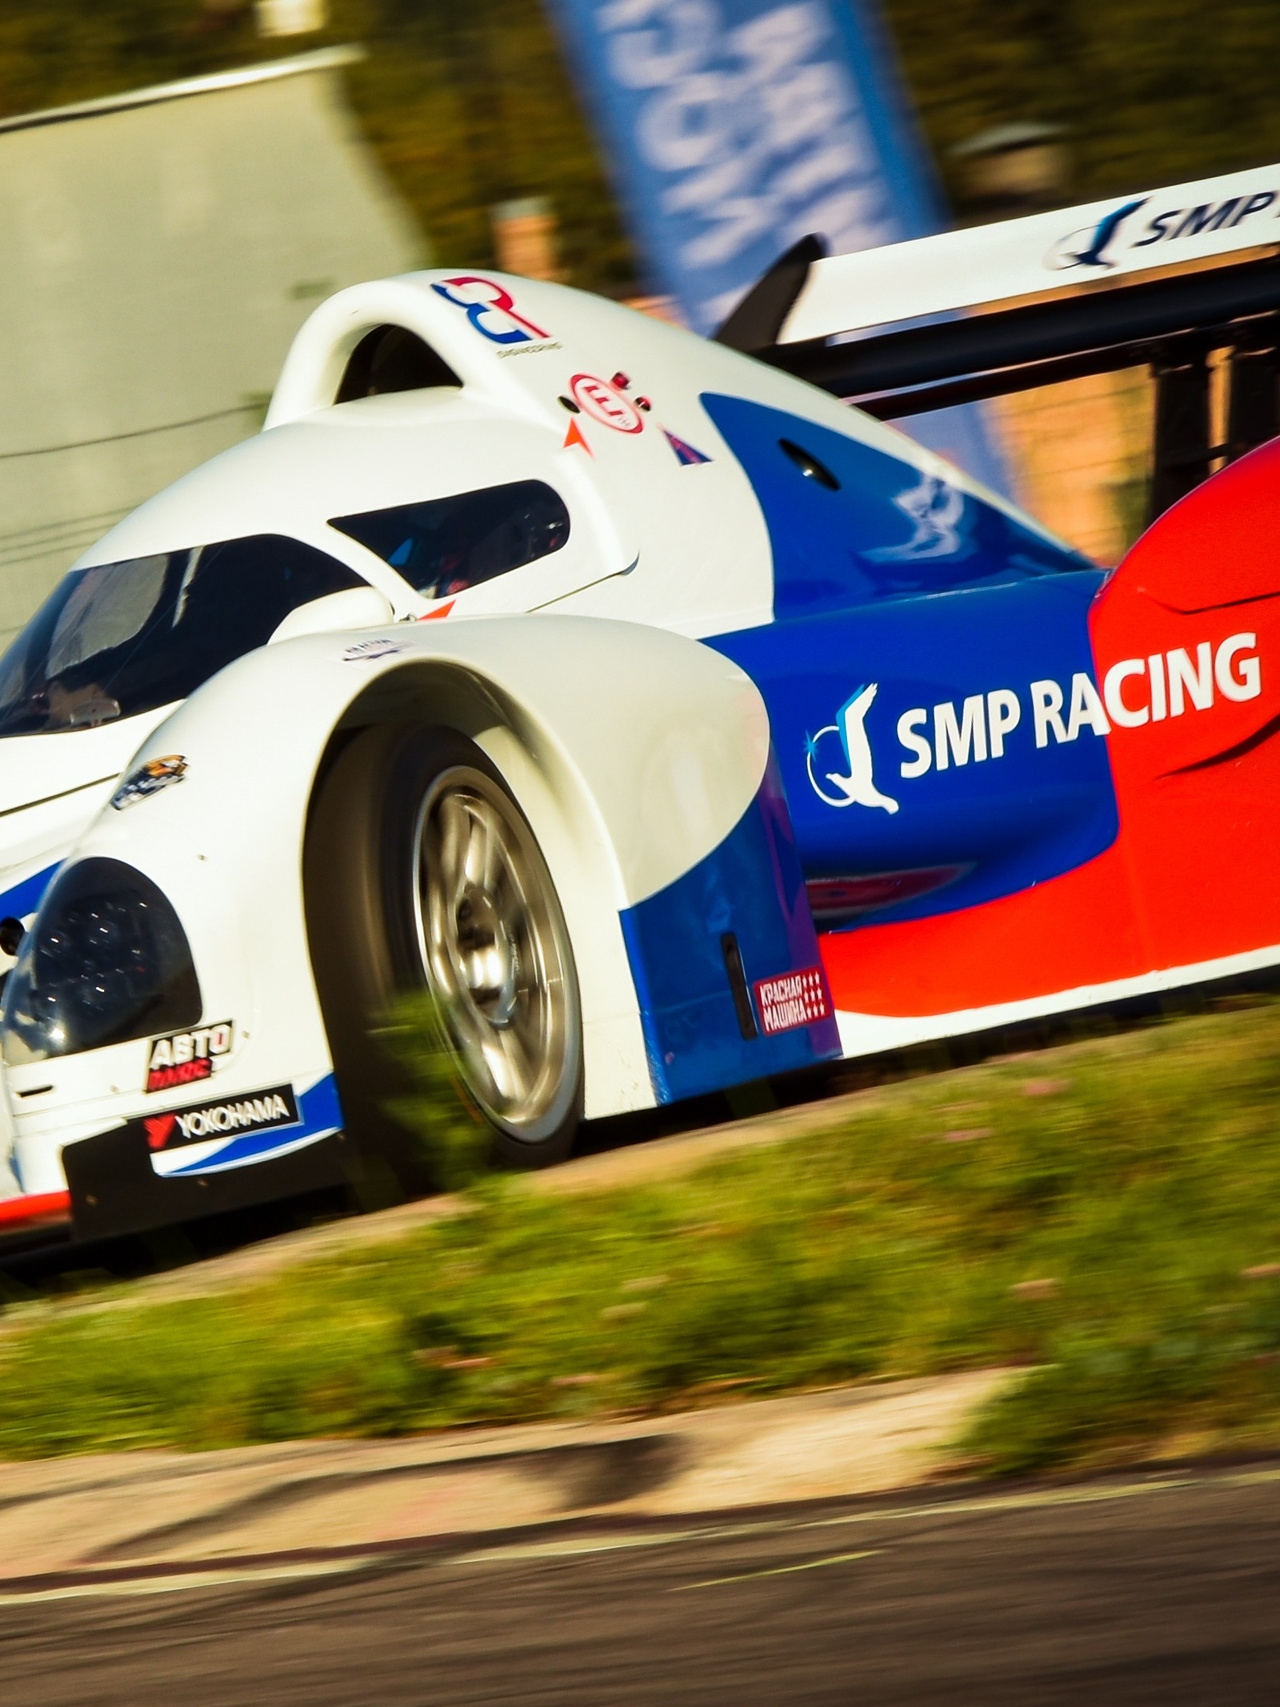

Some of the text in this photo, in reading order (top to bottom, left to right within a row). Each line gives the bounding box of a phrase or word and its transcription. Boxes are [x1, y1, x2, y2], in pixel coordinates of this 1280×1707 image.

[1132, 190, 1277, 248] SMP
[896, 632, 1261, 780] SMP RACING
[760, 975, 802, 1006] КРАСНАЯ
[762, 998, 807, 1032] МАШИНА
[150, 1024, 231, 1070] АВТО
[176, 1094, 290, 1138] YOKOHAMA
